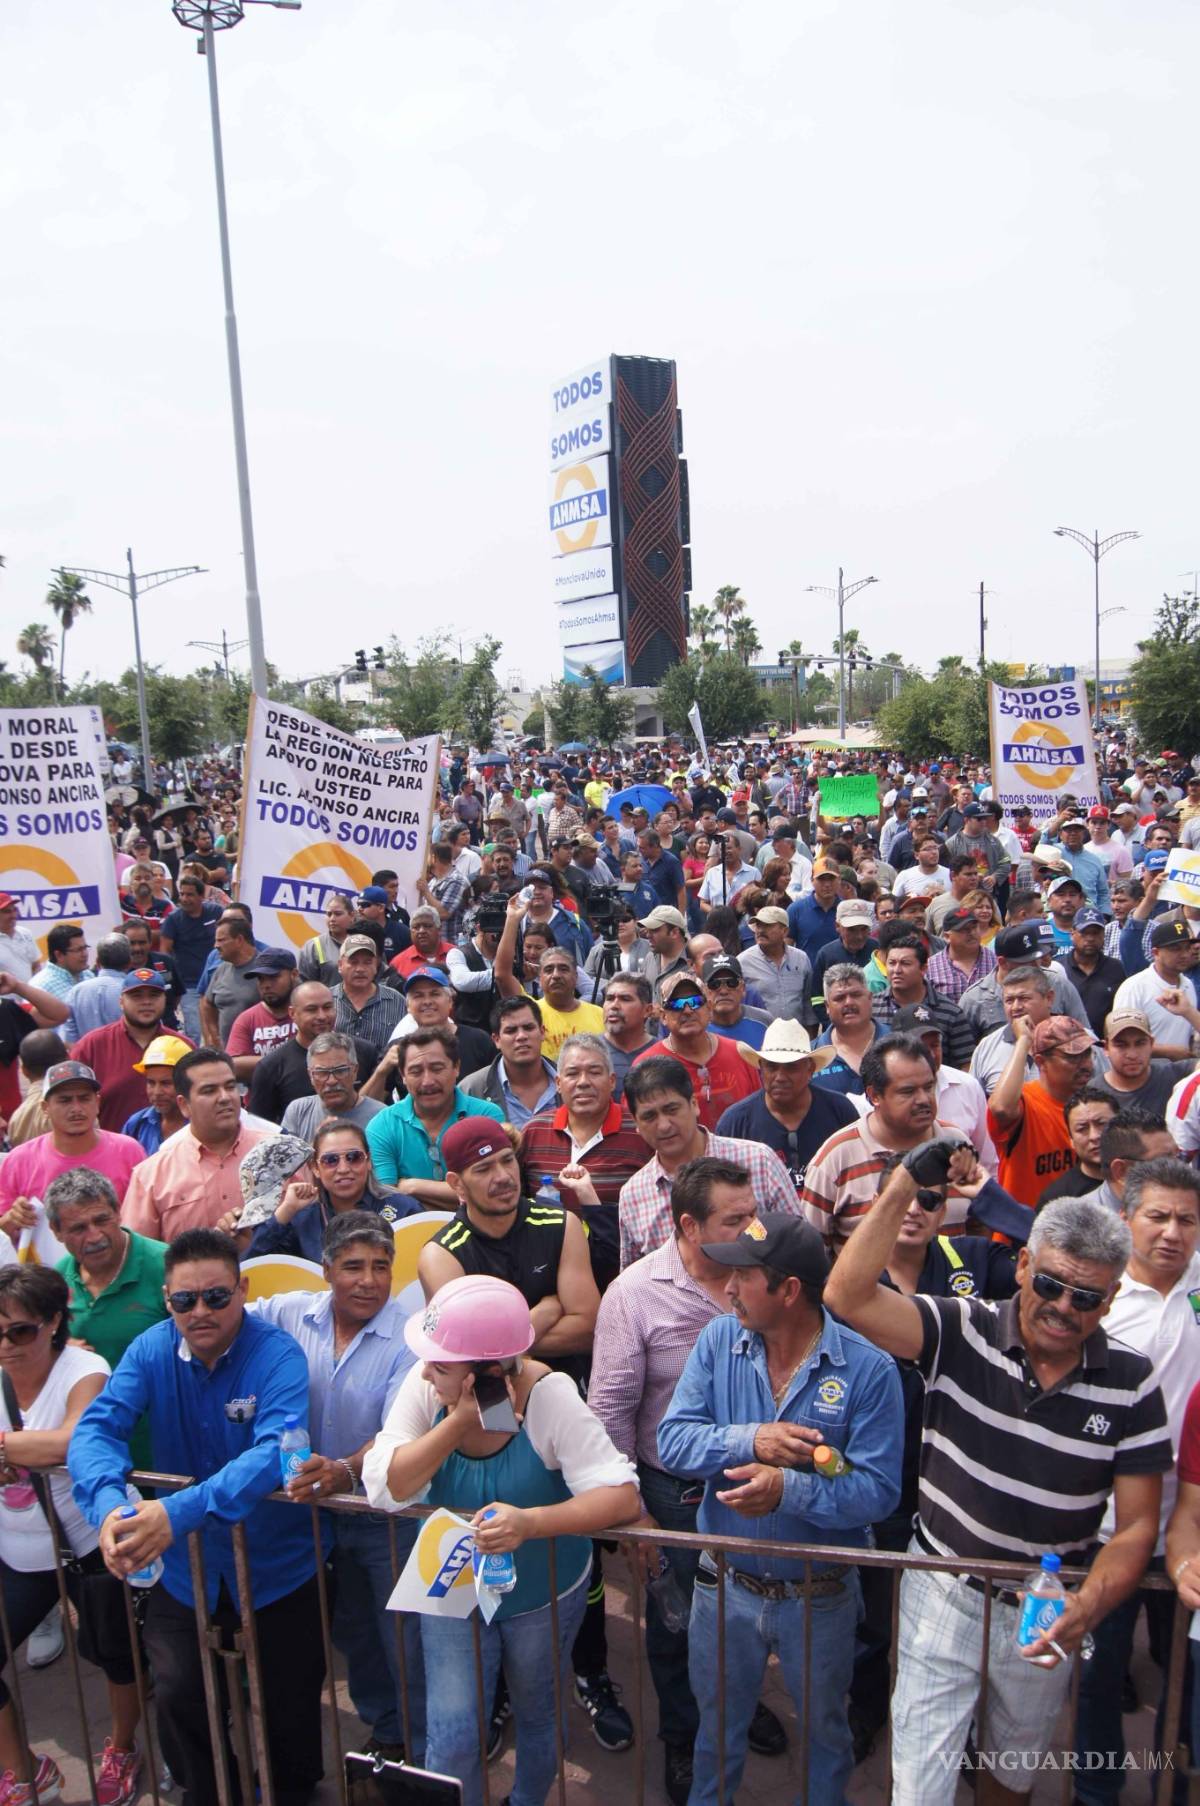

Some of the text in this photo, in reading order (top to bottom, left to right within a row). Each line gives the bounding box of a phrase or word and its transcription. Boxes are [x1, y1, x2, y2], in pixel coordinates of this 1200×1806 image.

[553, 371, 603, 413] TODOS
[551, 419, 603, 459] SOMOS
[553, 494, 602, 528] AHMSA
[998, 686, 1076, 705] TODOS
[1000, 702, 1081, 720] SOMOS
[8, 717, 78, 736] MORAL
[267, 710, 321, 737] DESDE
[11, 740, 78, 759] DESDE
[265, 725, 428, 773] LA REGION NUESTRO
[1008, 746, 1077, 764] AHMSA
[48, 761, 95, 781] PARA
[266, 744, 423, 791] APOYO MORAL PARA
[48, 784, 99, 804] ANCIRA
[315, 778, 371, 801] USTED
[999, 794, 1025, 805] TODOS
[1026, 794, 1053, 805] SOMOS
[259, 779, 420, 825] LIC. ALONSO ANCIRA
[17, 809, 103, 836] SOMOS
[256, 799, 418, 852] TODOS SOMOS
[1174, 923, 1184, 935] P
[253, 1023, 290, 1041] AERO
